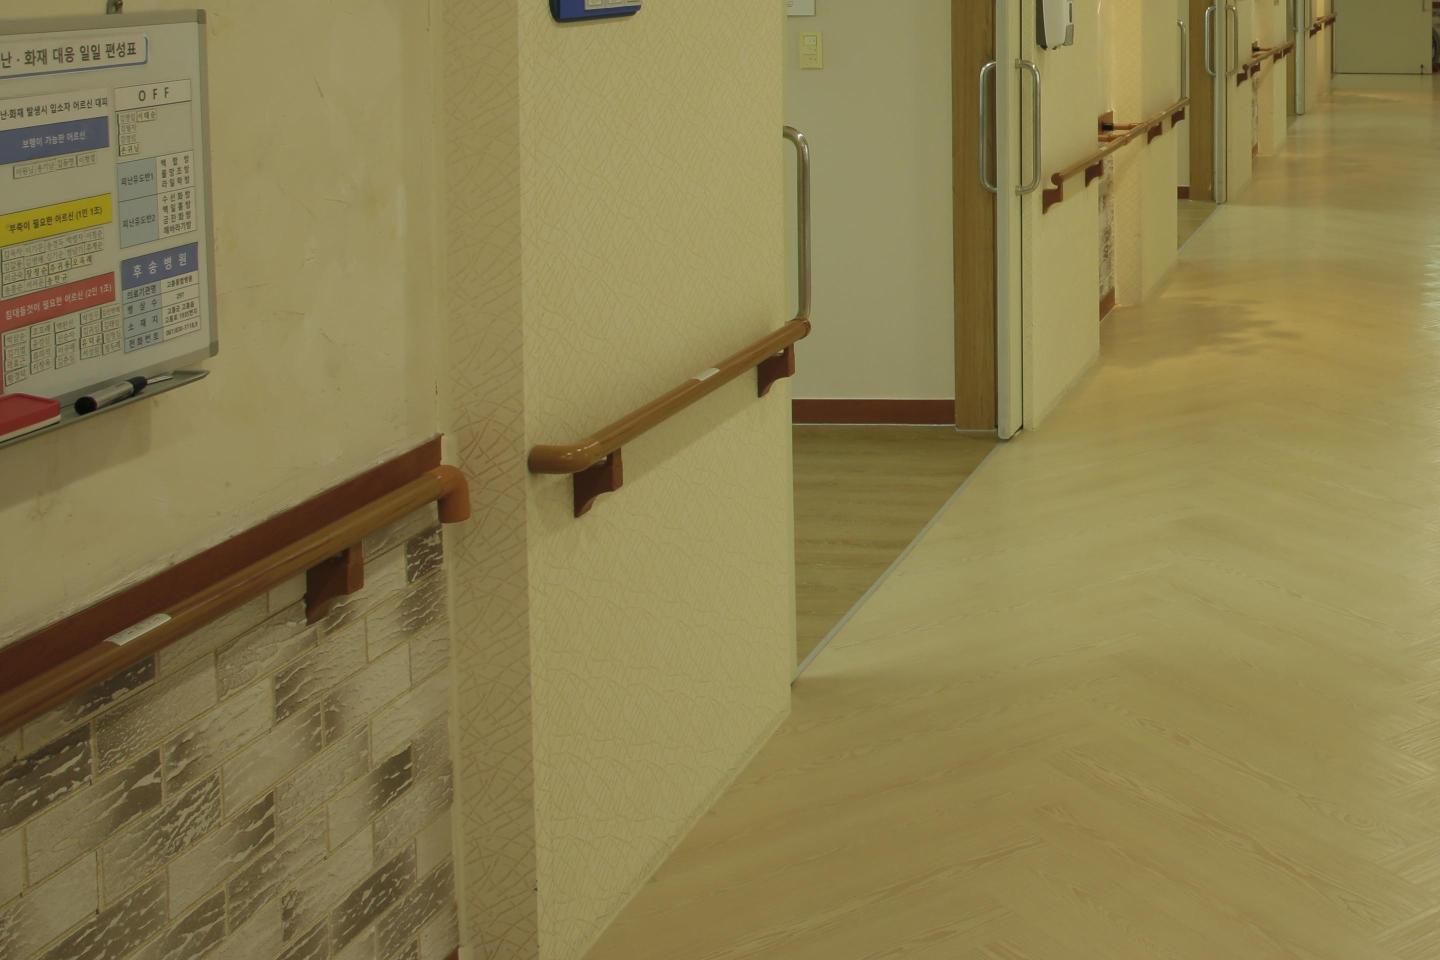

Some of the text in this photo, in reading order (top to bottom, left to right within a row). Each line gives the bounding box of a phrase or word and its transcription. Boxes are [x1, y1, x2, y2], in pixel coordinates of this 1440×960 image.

[24, 48, 48, 66] 화재
[53, 46, 75, 64] 대응
[80, 43, 101, 61] 일일
[105, 40, 137, 59] 편성표
[26, 104, 48, 117] 발생시
[50, 101, 71, 114] 입소자
[73, 98, 93, 111] 어르신
[95, 96, 108, 108] 대피
[45, 133, 65, 145] 가능한
[66, 129, 86, 142] 어르신
[33, 216, 53, 229] 필요한
[55, 211, 74, 223] 어르신
[64, 291, 84, 303] 어르신
